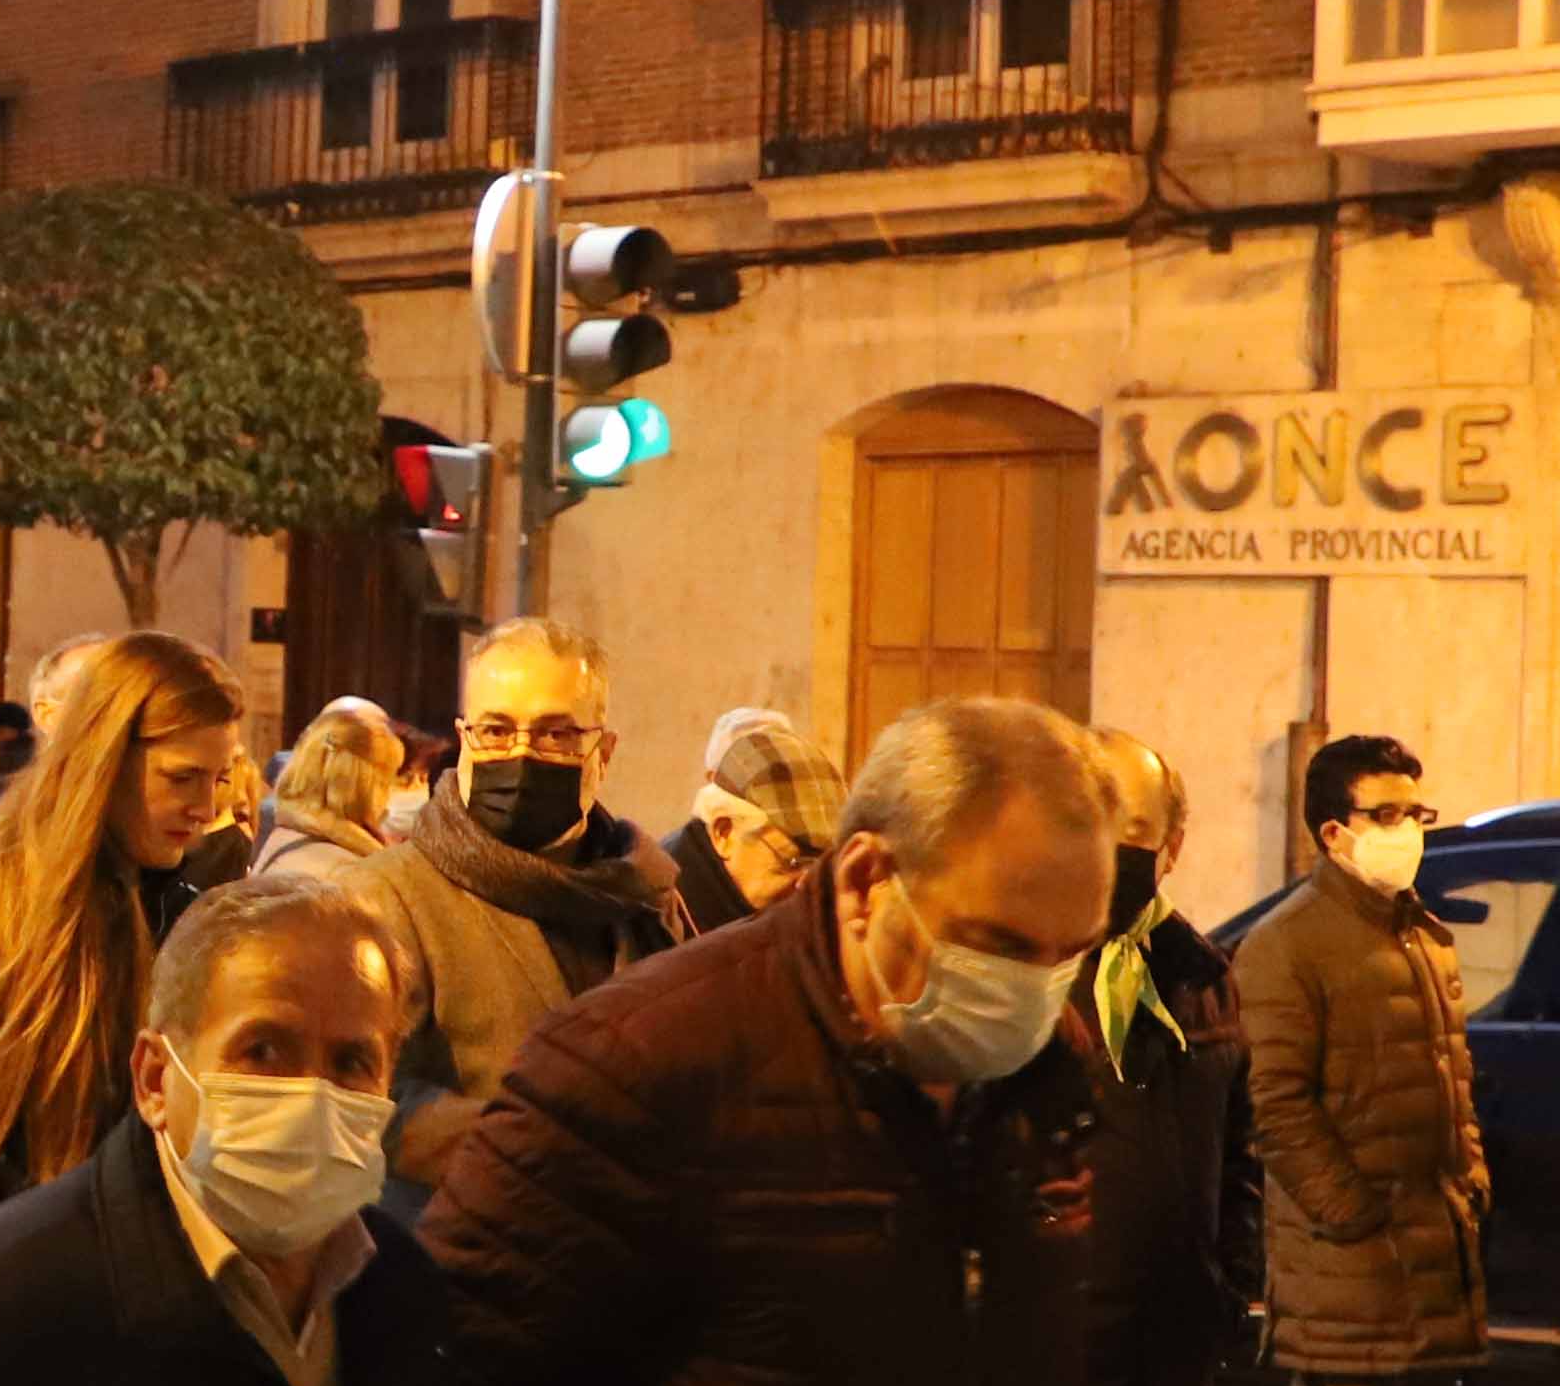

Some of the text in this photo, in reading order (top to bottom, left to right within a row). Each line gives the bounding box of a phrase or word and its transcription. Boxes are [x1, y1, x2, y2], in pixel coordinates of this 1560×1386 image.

[1172, 403, 1512, 512] ONCE
[1120, 527, 1494, 562] AGENCIA PROVINCIAL
